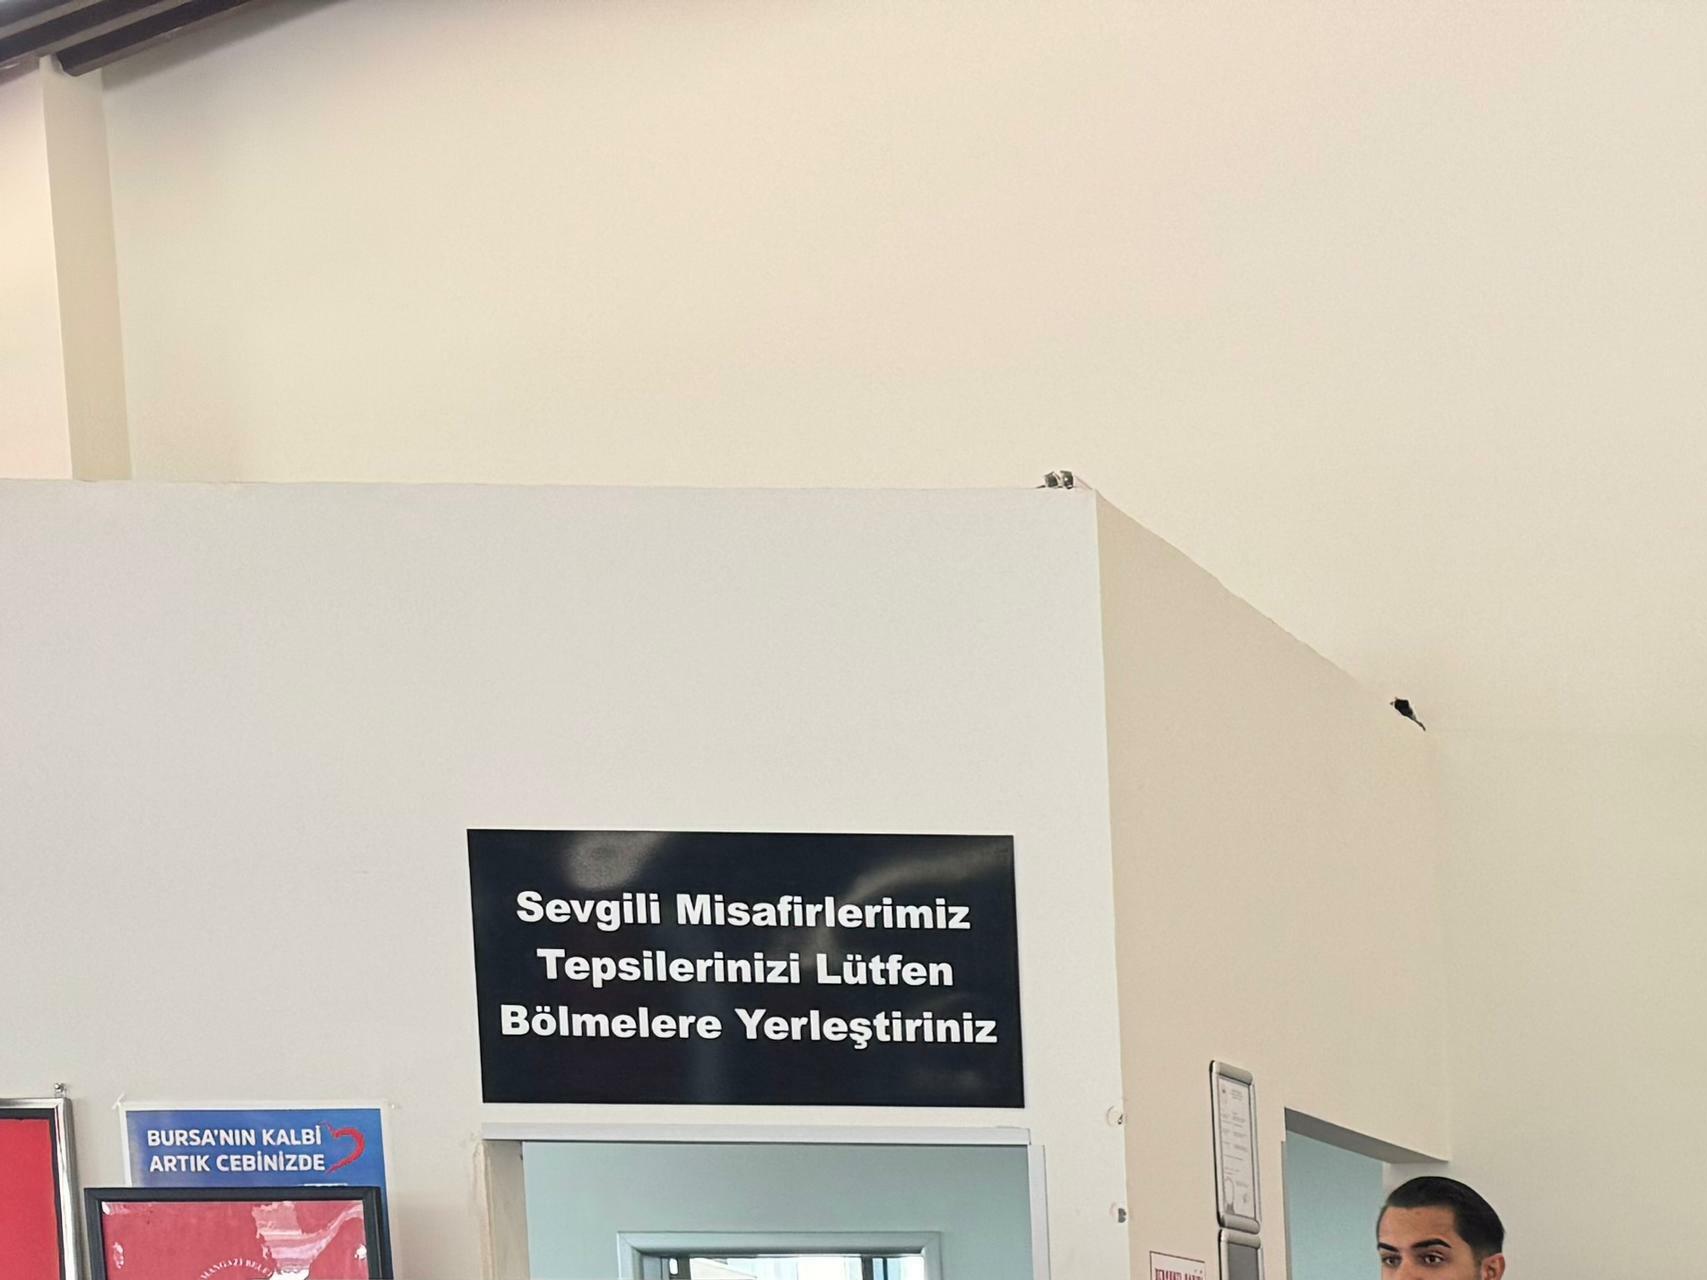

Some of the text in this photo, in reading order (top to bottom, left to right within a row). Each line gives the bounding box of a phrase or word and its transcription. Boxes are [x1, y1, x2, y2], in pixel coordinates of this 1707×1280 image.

[516, 890, 971, 932] Sevgili Misafirlerimiz
[537, 947, 954, 988] Tepsilerinizi Lütfen
[500, 1003, 998, 1049] Bölmelere Yerleştiriniz
[147, 1125, 322, 1147] BURSA'NIN KALBİ
[149, 1151, 325, 1173] ARTIK CEBİNİZDE
